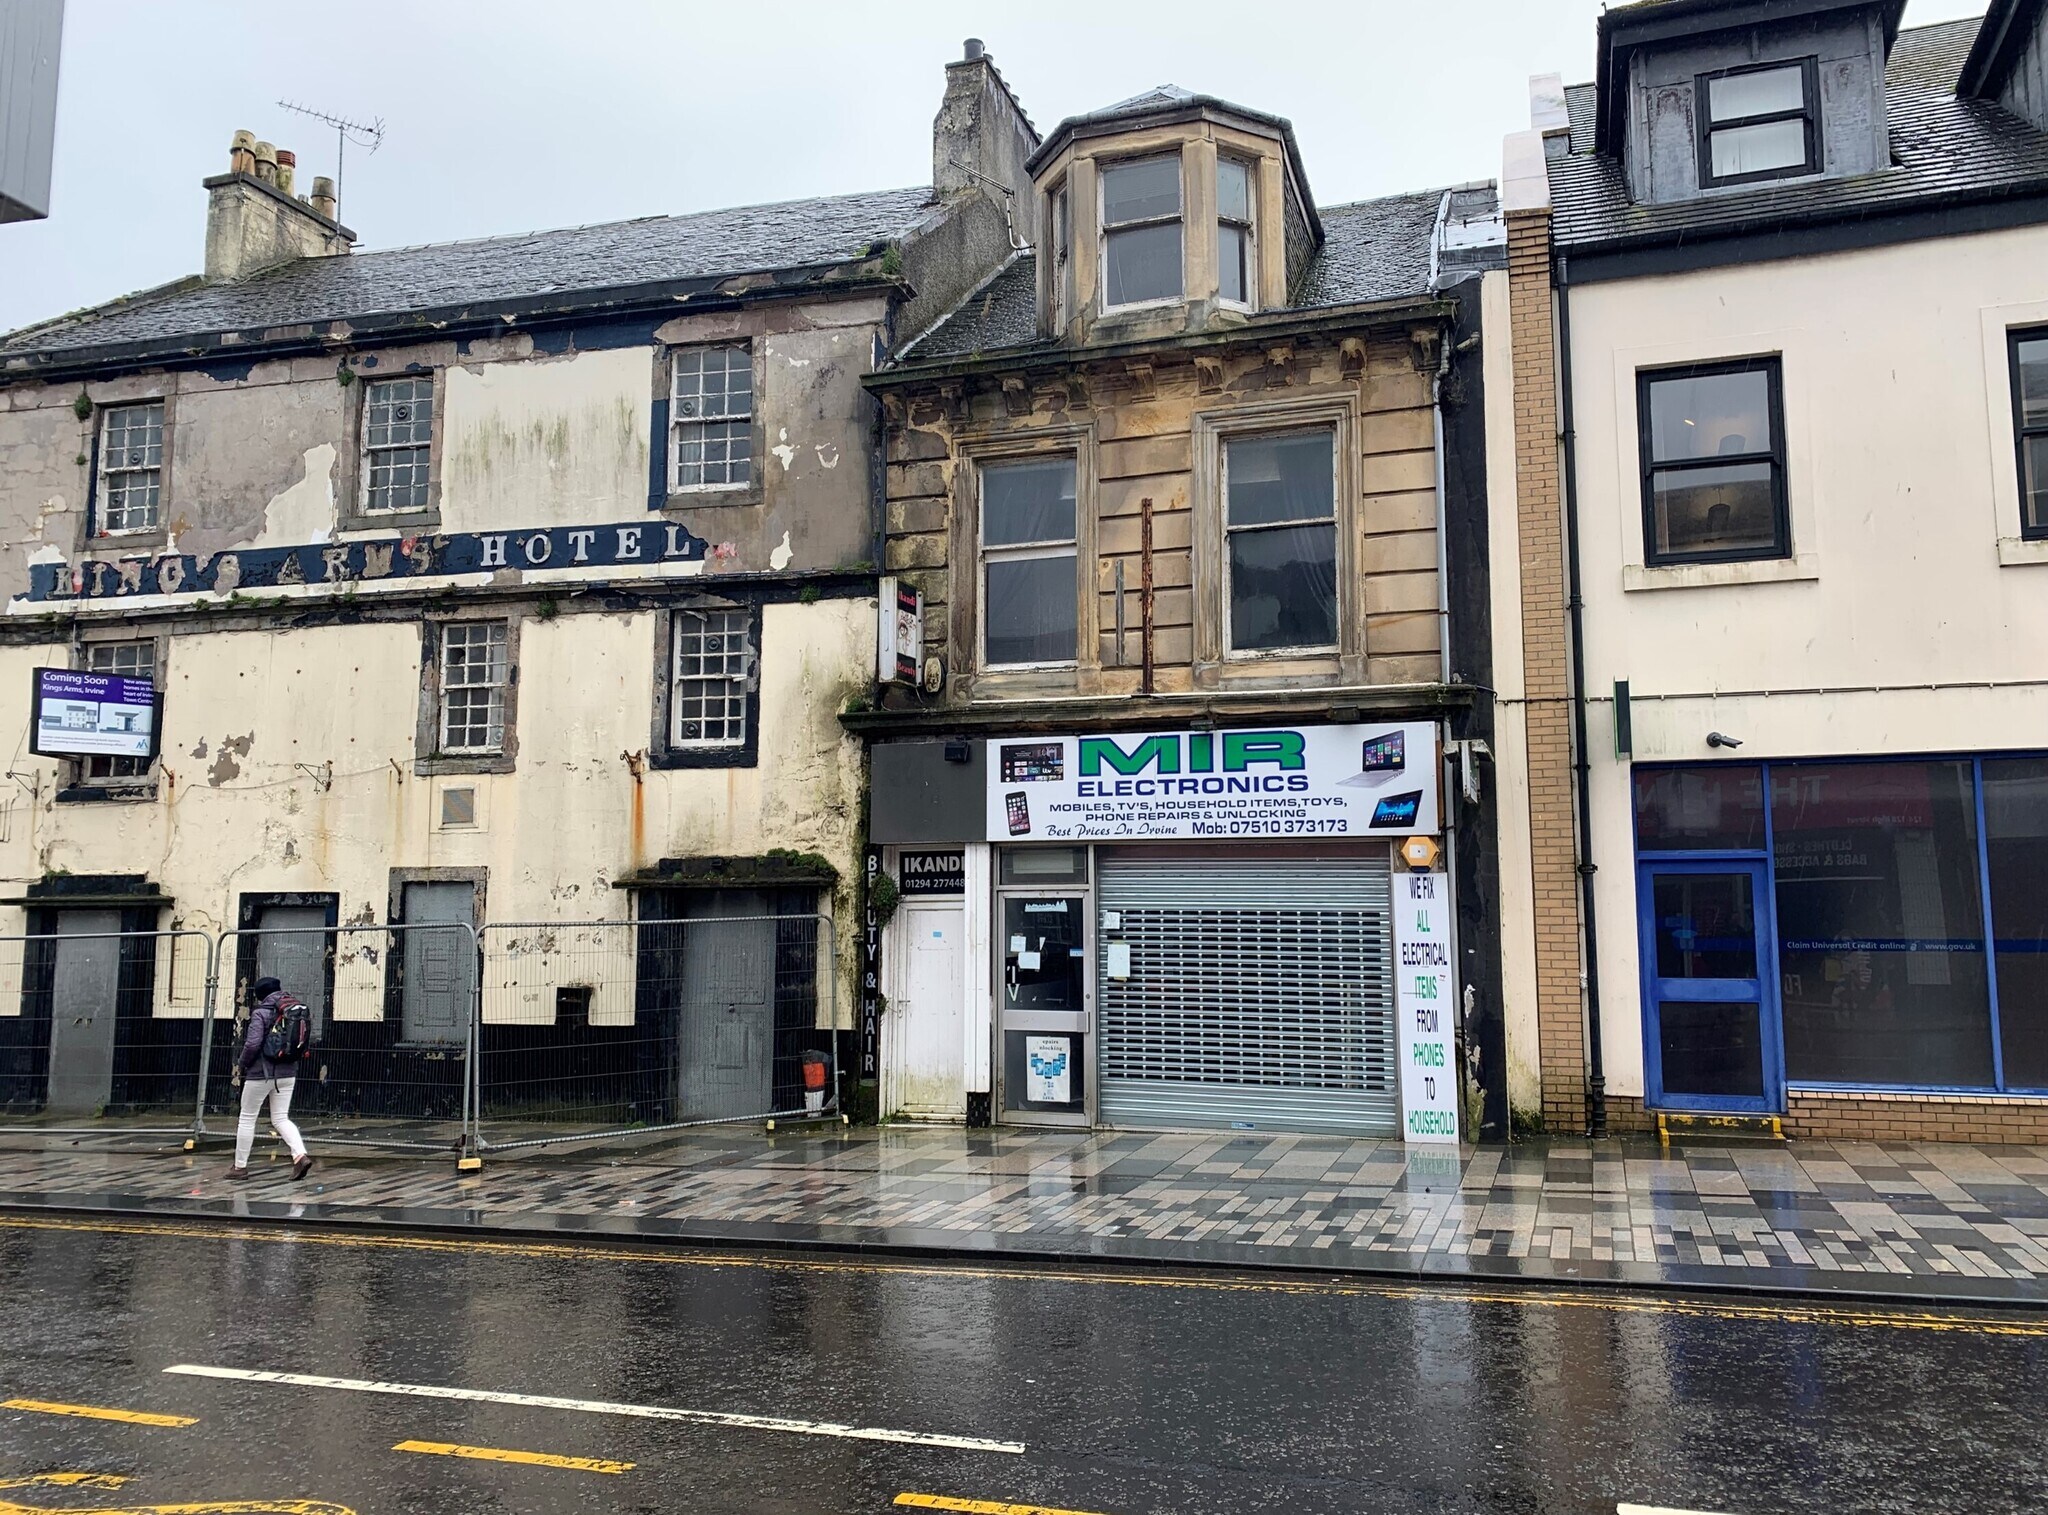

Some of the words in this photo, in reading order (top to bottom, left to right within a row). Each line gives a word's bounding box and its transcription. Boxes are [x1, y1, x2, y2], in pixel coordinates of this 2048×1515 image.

[480, 525, 690, 567] HOTEL
[42, 684, 63, 693] Kings
[63, 686, 84, 694] Arms,
[85, 687, 105, 695] Irvine
[43, 671, 82, 685] Coming
[84, 675, 108, 685] Soon
[1078, 730, 1306, 777] MIR
[1077, 774, 1309, 797] ELECTRONICS
[1049, 802, 1115, 812] MOBILES,
[1117, 801, 1153, 811] TV'S,
[1155, 800, 1247, 809] HOUSEHOLD
[1085, 812, 1135, 821] PHONE
[1137, 811, 1200, 821] REPAIRS
[1203, 811, 1213, 819] &
[1217, 809, 1306, 819] UNLOCKING
[1046, 824, 1071, 837] Best
[1075, 823, 1110, 838] Prices
[1113, 823, 1133, 835] In
[1136, 822, 1178, 835] Irvine
[1192, 822, 1227, 834] Mob:
[1230, 821, 1281, 834] 07510
[1284, 819, 1348, 832] 373173
[905, 878, 931, 889] 01294
[933, 878, 965, 888] 277448
[1408, 876, 1421, 899] WE
[1423, 876, 1435, 899] FIX
[867, 855, 877, 961] BEUTY
[1416, 909, 1431, 932] ALL
[1402, 942, 1448, 966] ELECTRICAL
[1787, 941, 1810, 949] Claim
[1812, 941, 1850, 949] Universal
[1852, 941, 1878, 949] Credit
[1925, 942, 1976, 951] www.gov.uk
[866, 972, 876, 988] &
[1414, 975, 1437, 1000] ITEMS
[1416, 1009, 1439, 1033] FROM
[865, 1000, 875, 1072] HAIR
[1413, 1042, 1445, 1067] PHONES
[1424, 1077, 1436, 1101] TO
[1408, 1110, 1455, 1136] HOUSEHOLD
